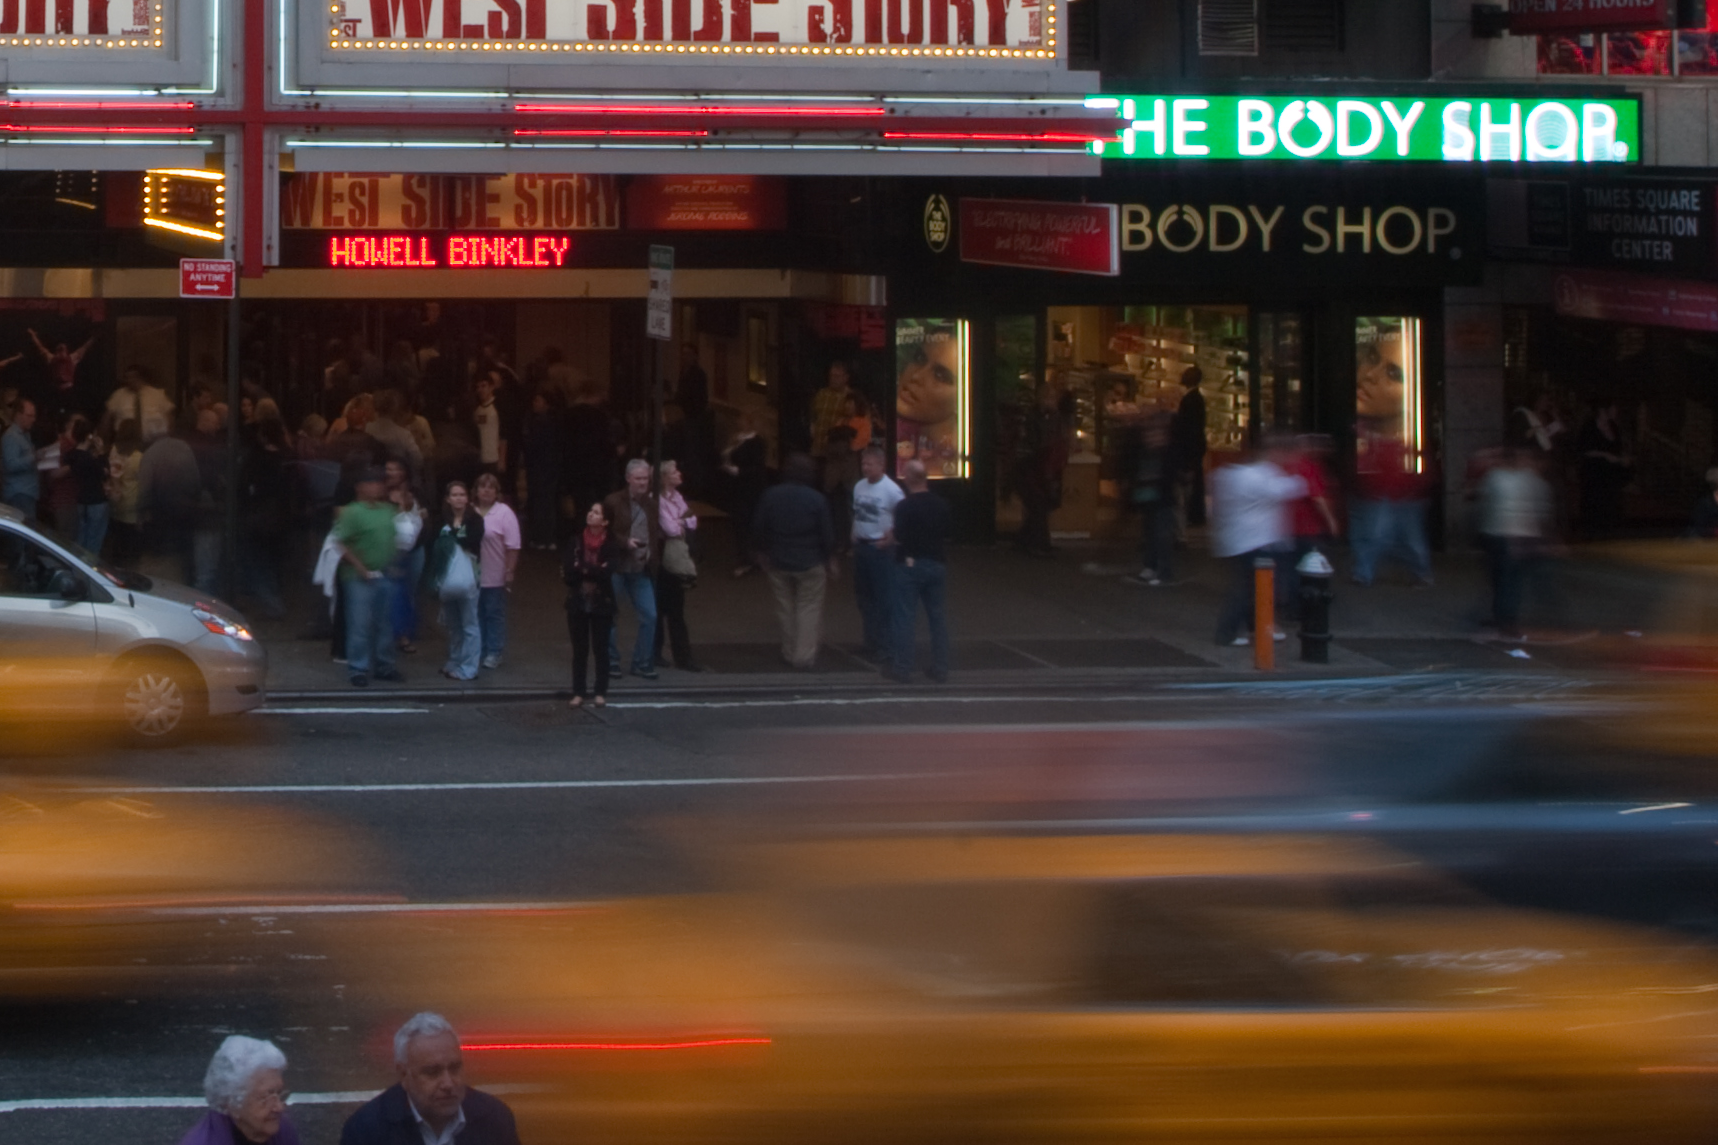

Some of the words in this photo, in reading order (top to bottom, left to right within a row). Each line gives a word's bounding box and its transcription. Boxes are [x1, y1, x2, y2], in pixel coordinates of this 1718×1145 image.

[1238, 100, 1425, 157] BODY
[1442, 101, 1618, 161] SHOP
[283, 172, 380, 229] WEST
[400, 172, 500, 229] SIDE
[514, 172, 619, 229] STORY
[1585, 188, 1631, 206] TIMES
[1636, 189, 1702, 212] SQUARE
[1122, 204, 1285, 254] BODY
[1302, 205, 1457, 254] SHOP
[1586, 213, 1698, 237] INFORMATION
[331, 237, 436, 266] HOWELL
[449, 237, 570, 266] BINKLEY
[1610, 237, 1674, 261] CENTER
[183, 262, 194, 272] NO
[197, 263, 232, 273] STANDING
[189, 273, 226, 283] ANYTIME
